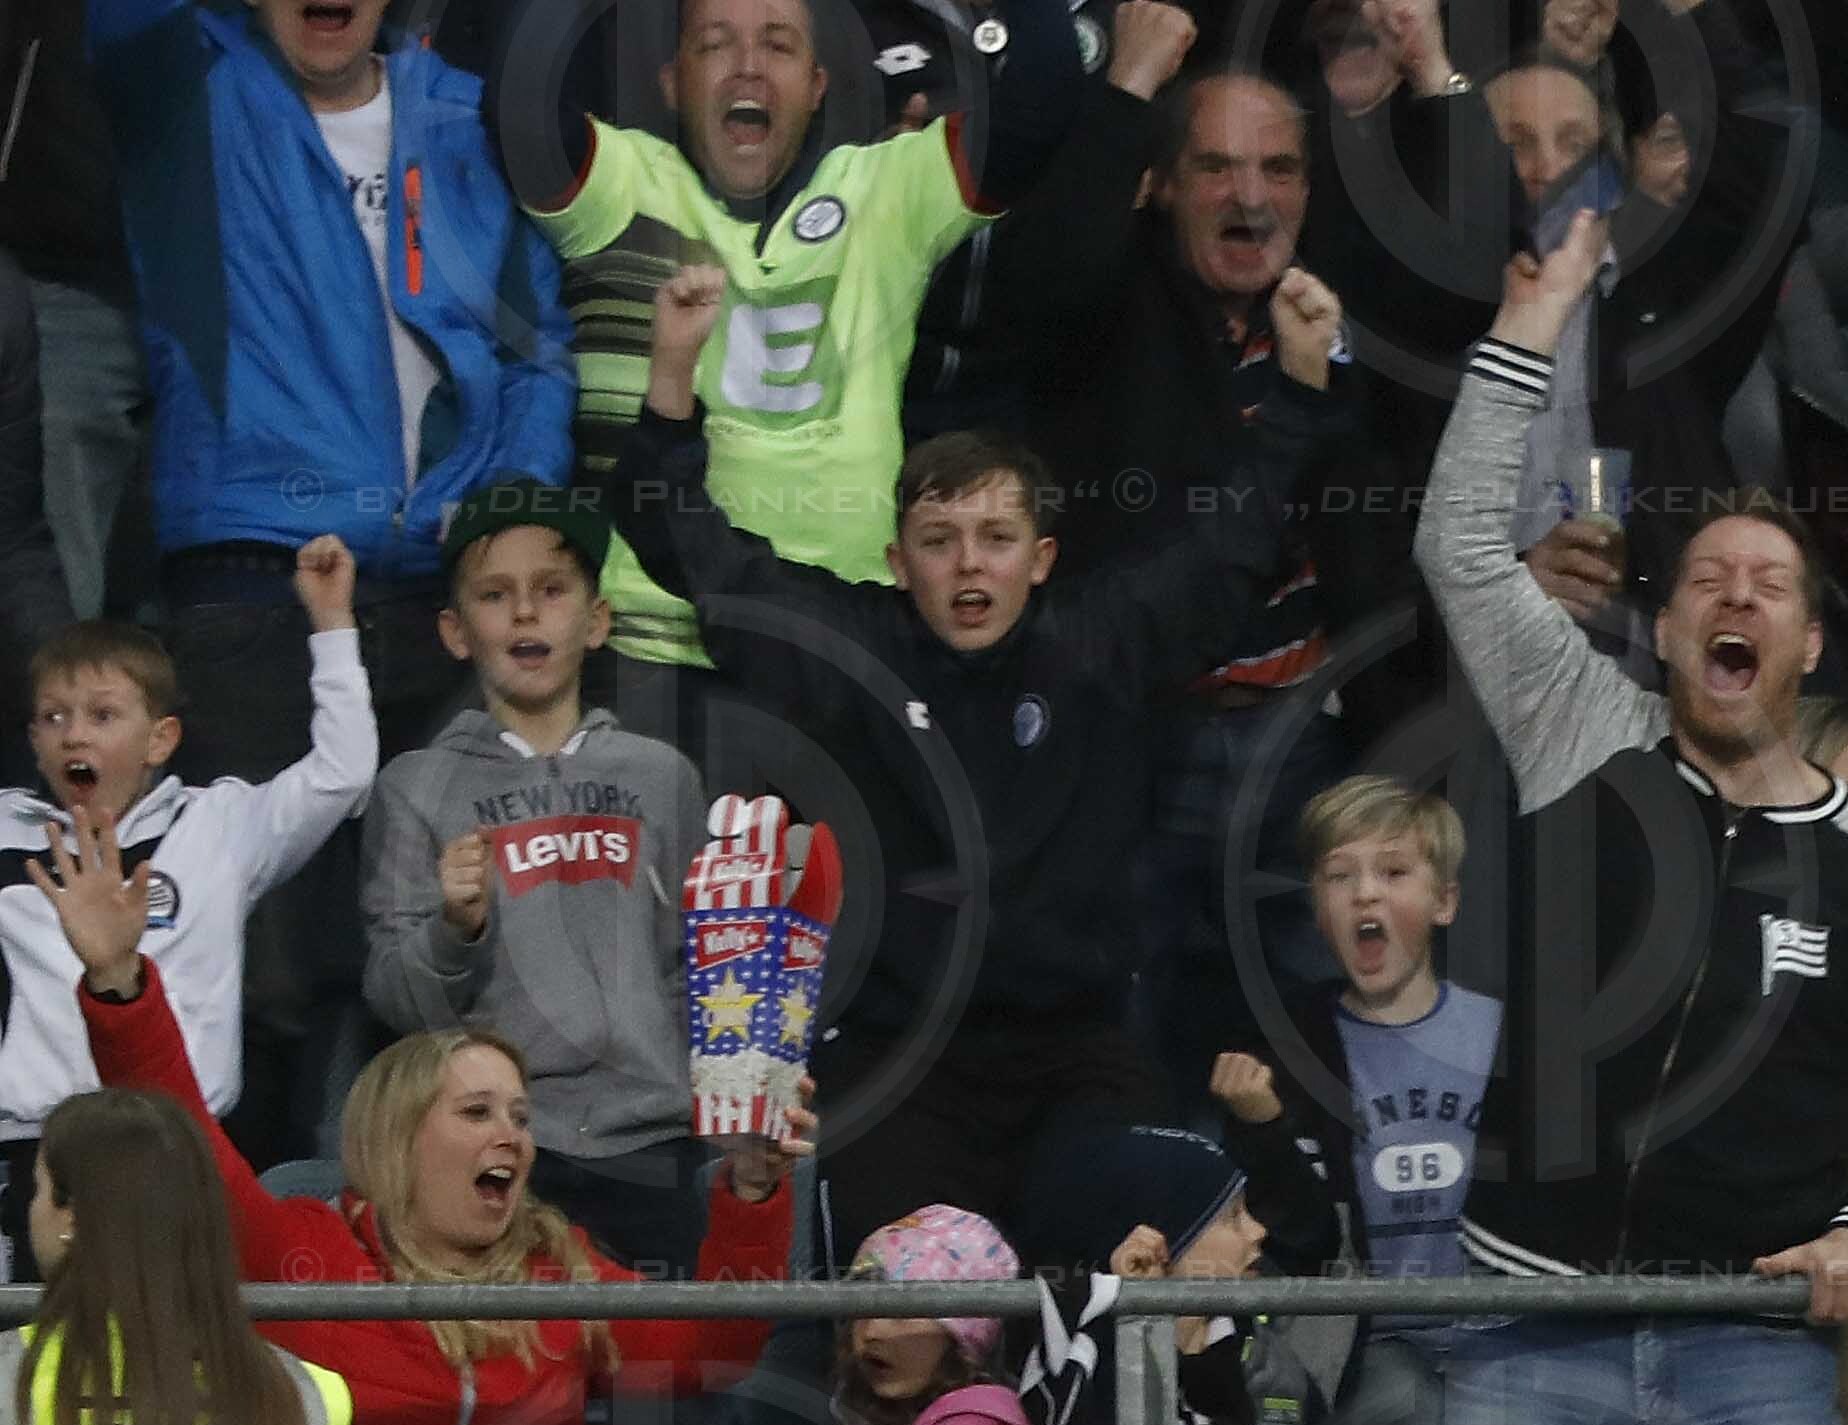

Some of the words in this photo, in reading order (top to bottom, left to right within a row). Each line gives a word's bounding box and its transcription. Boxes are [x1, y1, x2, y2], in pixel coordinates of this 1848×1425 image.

[474, 784, 552, 825] NEW
[561, 780, 643, 819] YORK
[504, 829, 630, 873] Levi's
[1395, 1152, 1441, 1184] 96
